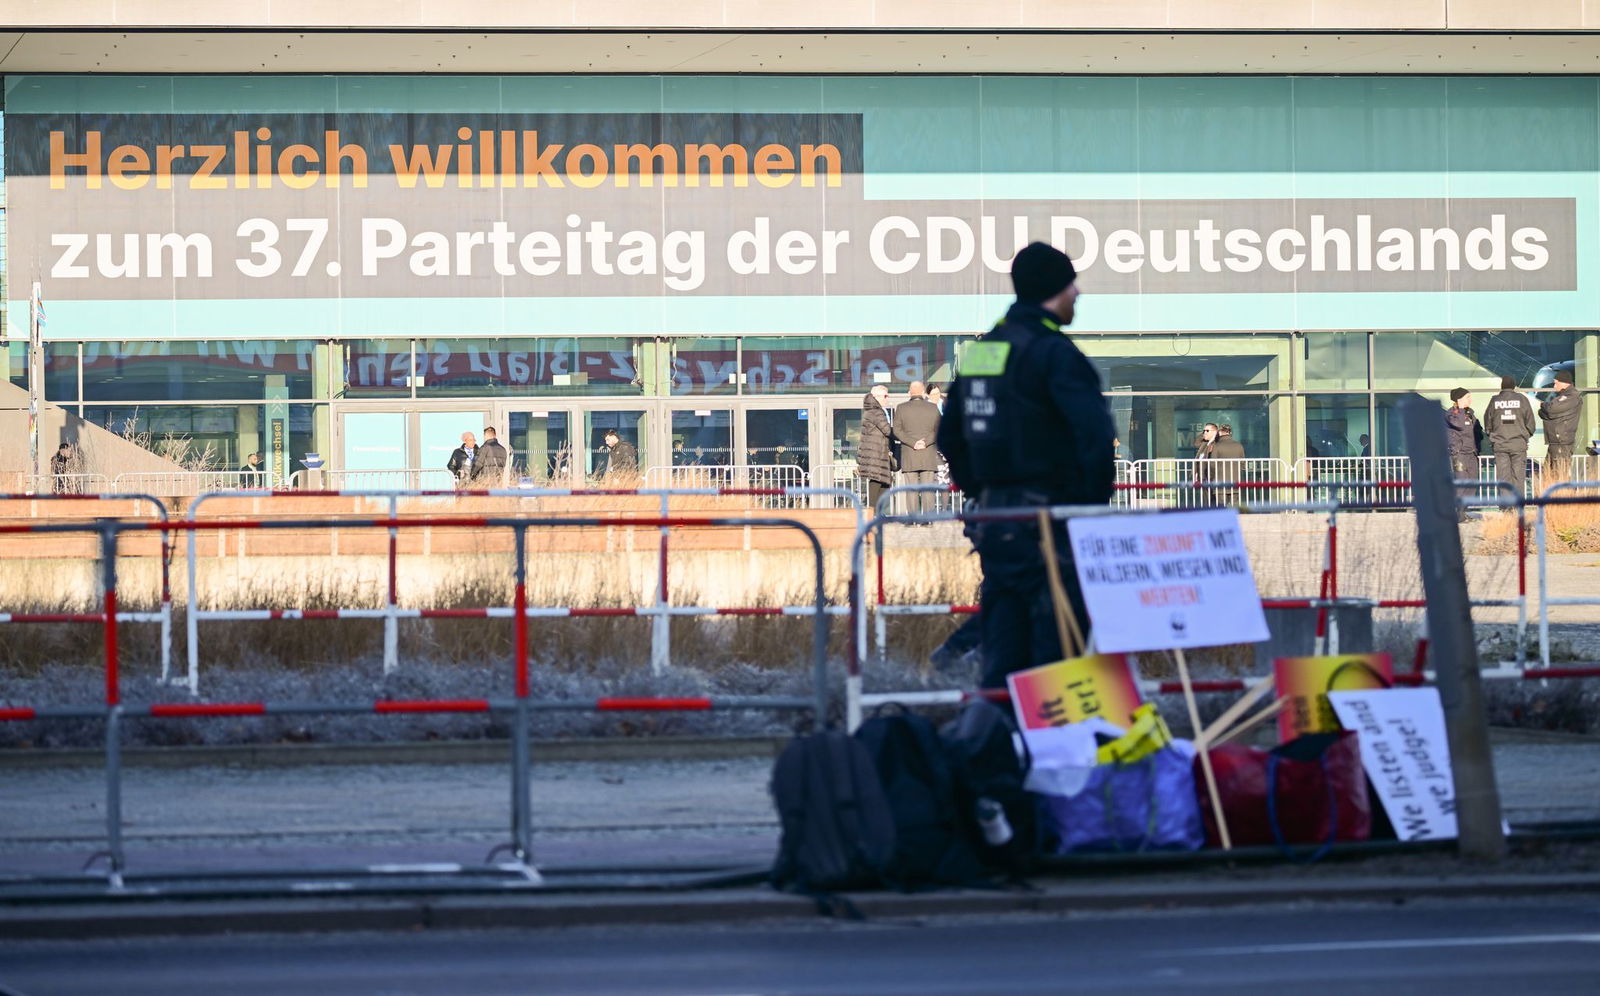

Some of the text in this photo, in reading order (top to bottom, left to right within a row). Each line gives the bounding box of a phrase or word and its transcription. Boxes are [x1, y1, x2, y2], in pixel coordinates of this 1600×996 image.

[49, 127, 843, 190] Herzlich willkommen
[51, 213, 1548, 292] zum 37. Parteitag der CDU Deutschlands
[1494, 400, 1520, 409] POLIZEI
[1143, 530, 1206, 555] ZUKUNFT
[1344, 700, 1433, 841] We listen and
[1387, 718, 1446, 779] judge!
